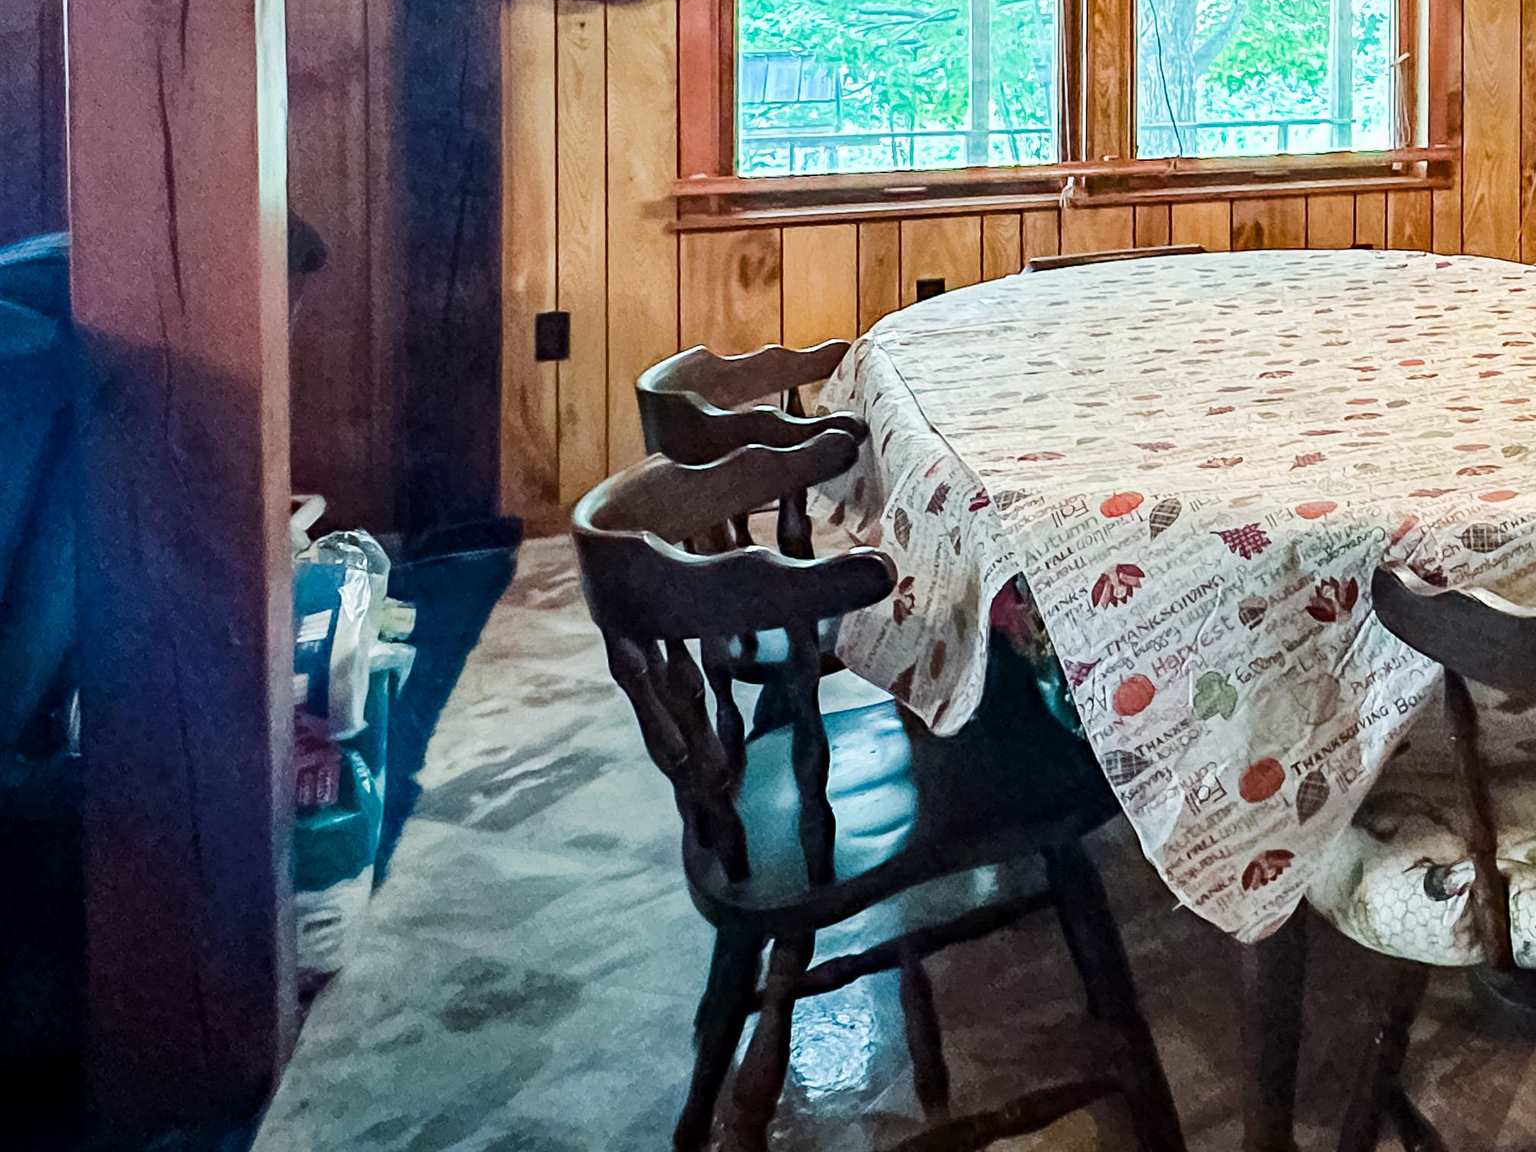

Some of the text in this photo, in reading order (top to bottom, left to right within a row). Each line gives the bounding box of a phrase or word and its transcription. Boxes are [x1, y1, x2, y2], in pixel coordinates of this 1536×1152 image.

[1051, 498, 1090, 529] Fall
[1023, 516, 1099, 568] Autumn
[1151, 615, 1235, 678] Harvest
[1134, 716, 1191, 760] THANKS
[1290, 705, 1390, 777] THANKSGIVING
[1184, 774, 1228, 816] Fall
